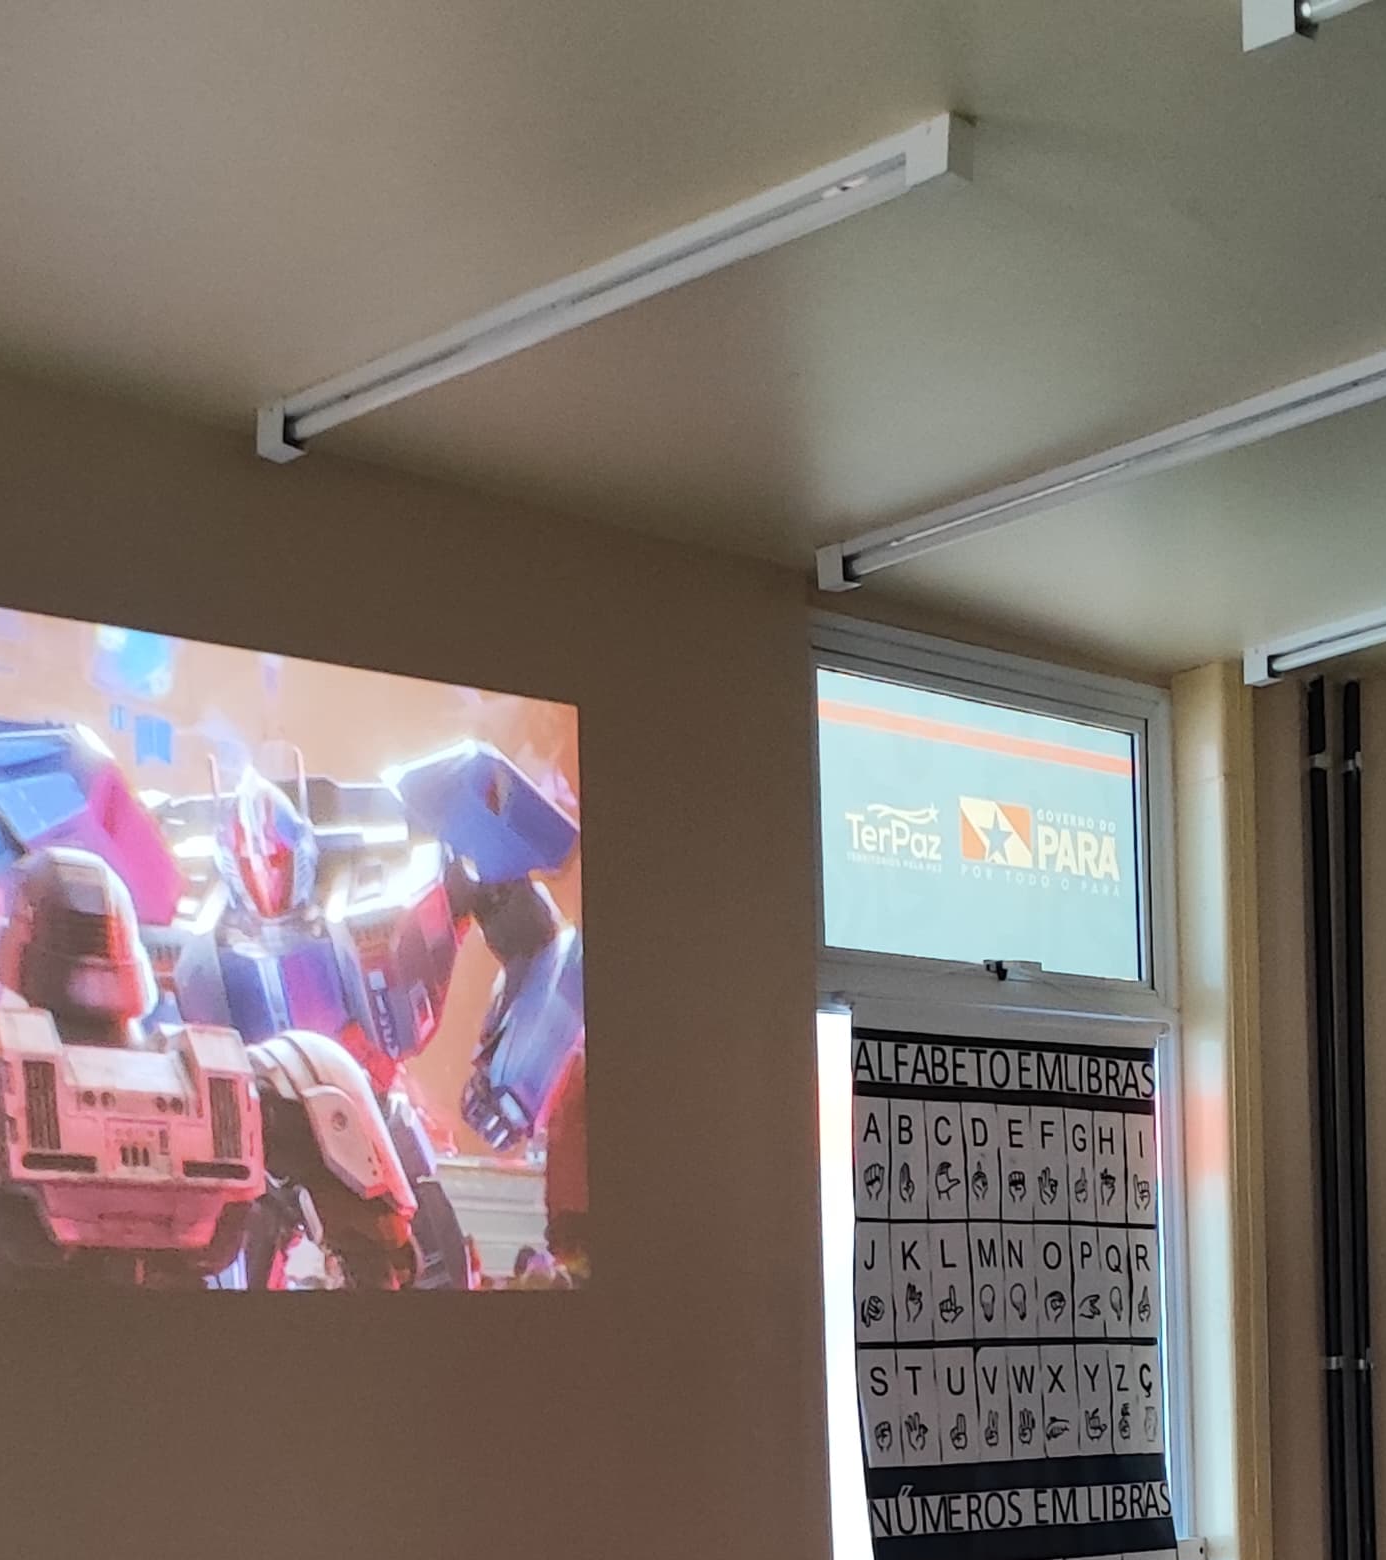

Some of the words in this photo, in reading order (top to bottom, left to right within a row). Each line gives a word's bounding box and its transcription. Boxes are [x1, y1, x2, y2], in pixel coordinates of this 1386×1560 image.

[845, 813, 942, 861] TerPaz
[1036, 808, 1094, 829] GOVERNO
[1099, 819, 1116, 834] DO
[960, 864, 994, 881] POR
[1005, 869, 1050, 889] TODO
[1061, 878, 1070, 891] O
[853, 1041, 1010, 1088] ALFABETO
[1064, 1054, 1156, 1099] LIBRAS
[863, 1112, 881, 1143] A
[898, 1114, 913, 1145] B
[934, 1116, 951, 1146] C
[972, 1118, 988, 1147] D
[1008, 1119, 1023, 1148] E
[1041, 1120, 1055, 1149] F
[1072, 1124, 1086, 1152] G
[1099, 1127, 1114, 1155] H
[864, 1240, 875, 1271] J
[902, 1241, 921, 1270] K
[941, 1239, 957, 1268] L
[978, 1239, 997, 1268] M
[1008, 1239, 1023, 1269] N
[1043, 1241, 1062, 1271] O
[1081, 1242, 1092, 1270] P
[1106, 1244, 1123, 1274] Q
[1136, 1244, 1149, 1271] R
[870, 1366, 889, 1396] S
[905, 1366, 922, 1395] T
[948, 1366, 966, 1395] U
[982, 1366, 998, 1394] V
[1013, 1366, 1035, 1394] W
[1048, 1365, 1066, 1393] X
[1084, 1364, 1100, 1392] Y
[1116, 1365, 1129, 1391] Z
[1139, 1363, 1152, 1398] Ç
[870, 1484, 1023, 1536] NÚMEROS
[1034, 1487, 1078, 1524] EM
[1087, 1482, 1171, 1521] LIBRAS
